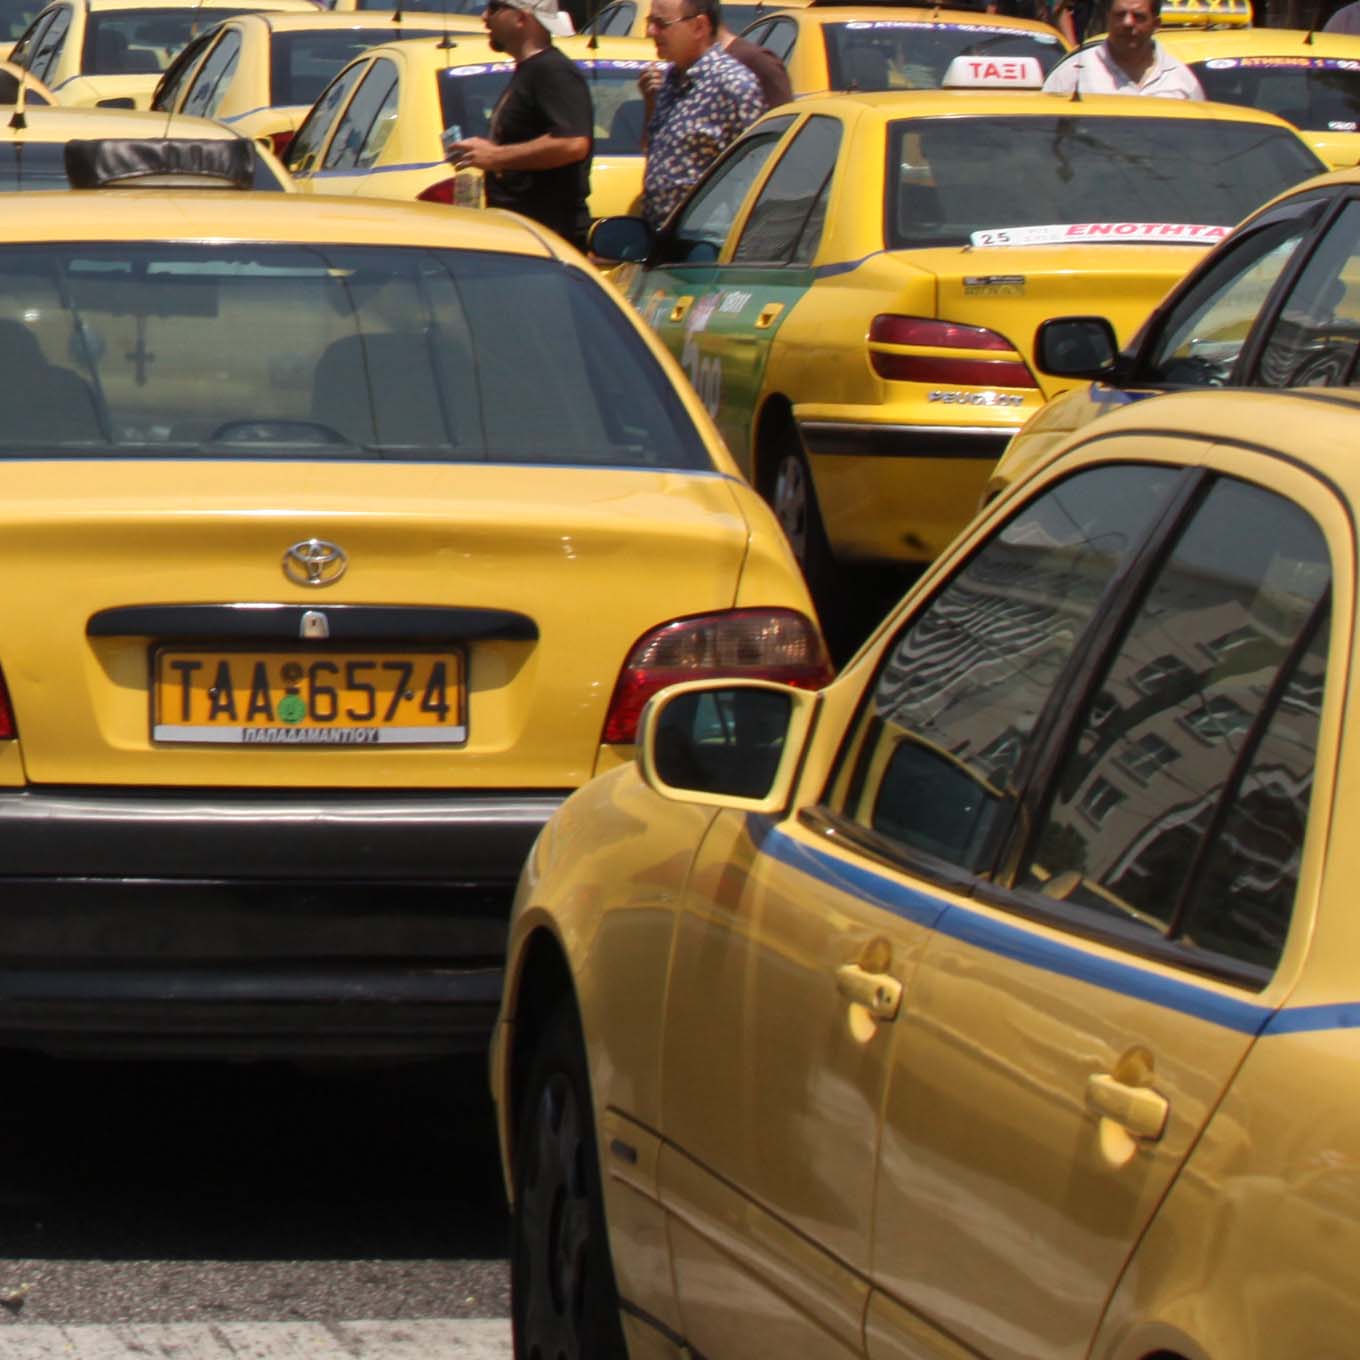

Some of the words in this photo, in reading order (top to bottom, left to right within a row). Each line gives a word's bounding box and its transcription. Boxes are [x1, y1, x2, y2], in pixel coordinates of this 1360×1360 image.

[1240, 58, 1311, 68] ATHENS
[969, 62, 1028, 80] ΤΑΞΙ
[982, 231, 1011, 245] 25
[244, 728, 377, 742] ΠΑΠΑΔΑΜΑΝΤΙΟΥ
